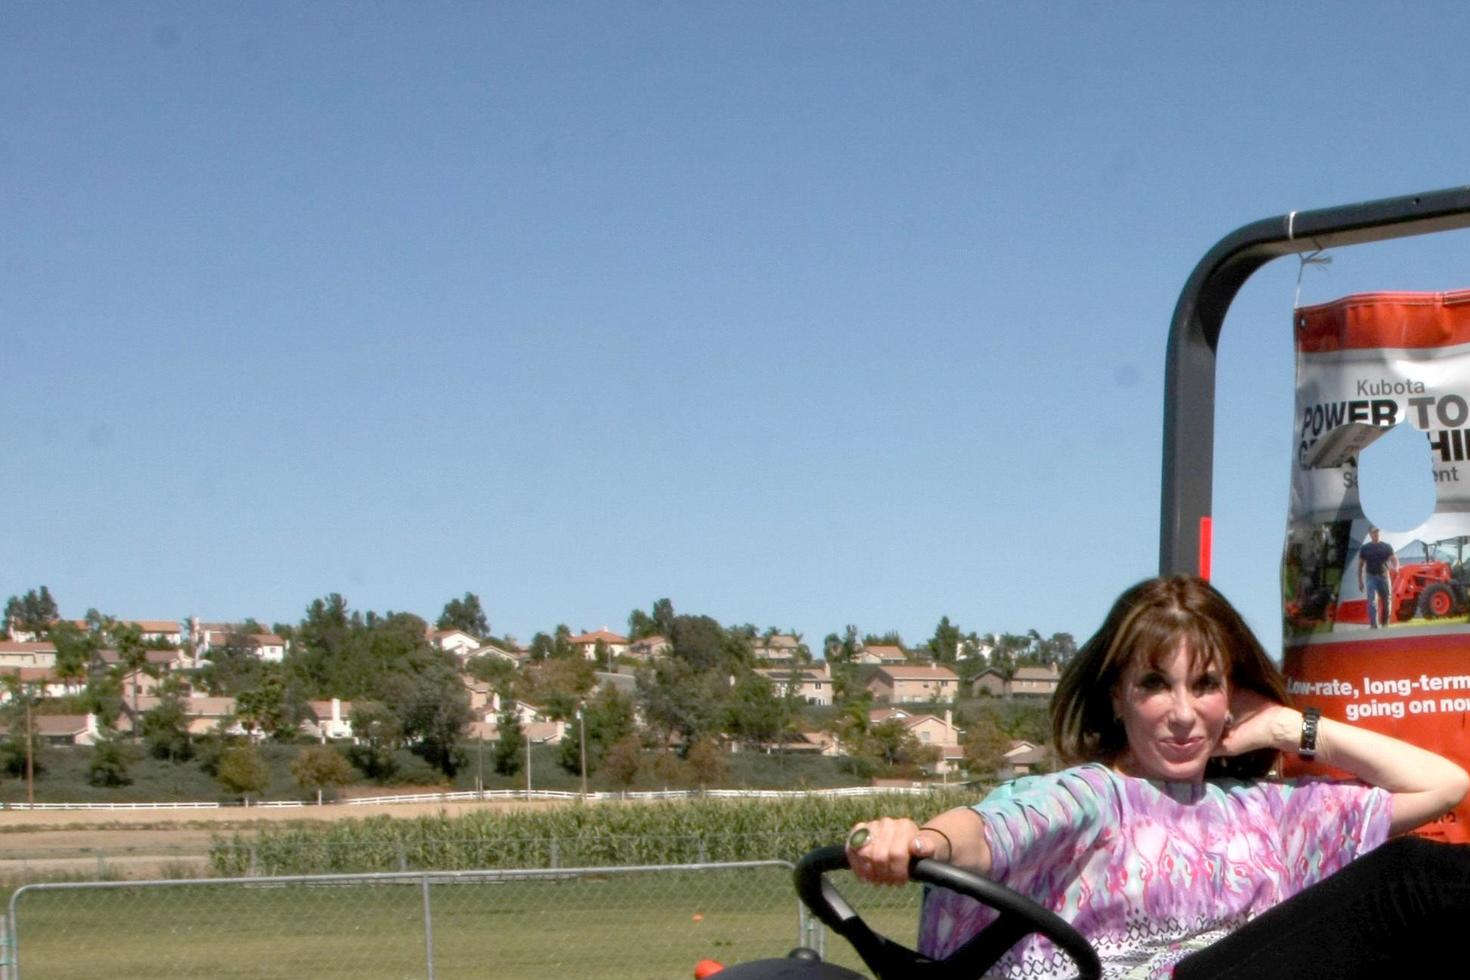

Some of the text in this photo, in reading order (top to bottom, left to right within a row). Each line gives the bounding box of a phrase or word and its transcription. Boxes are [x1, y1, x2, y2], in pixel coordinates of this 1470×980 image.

[1357, 379, 1425, 397] Kubota
[1302, 399, 1399, 438] POWER
[1408, 394, 1469, 429] TO
[1286, 677, 1360, 699] Low-rate,
[1345, 699, 1405, 721] going
[1408, 700, 1437, 714] on
